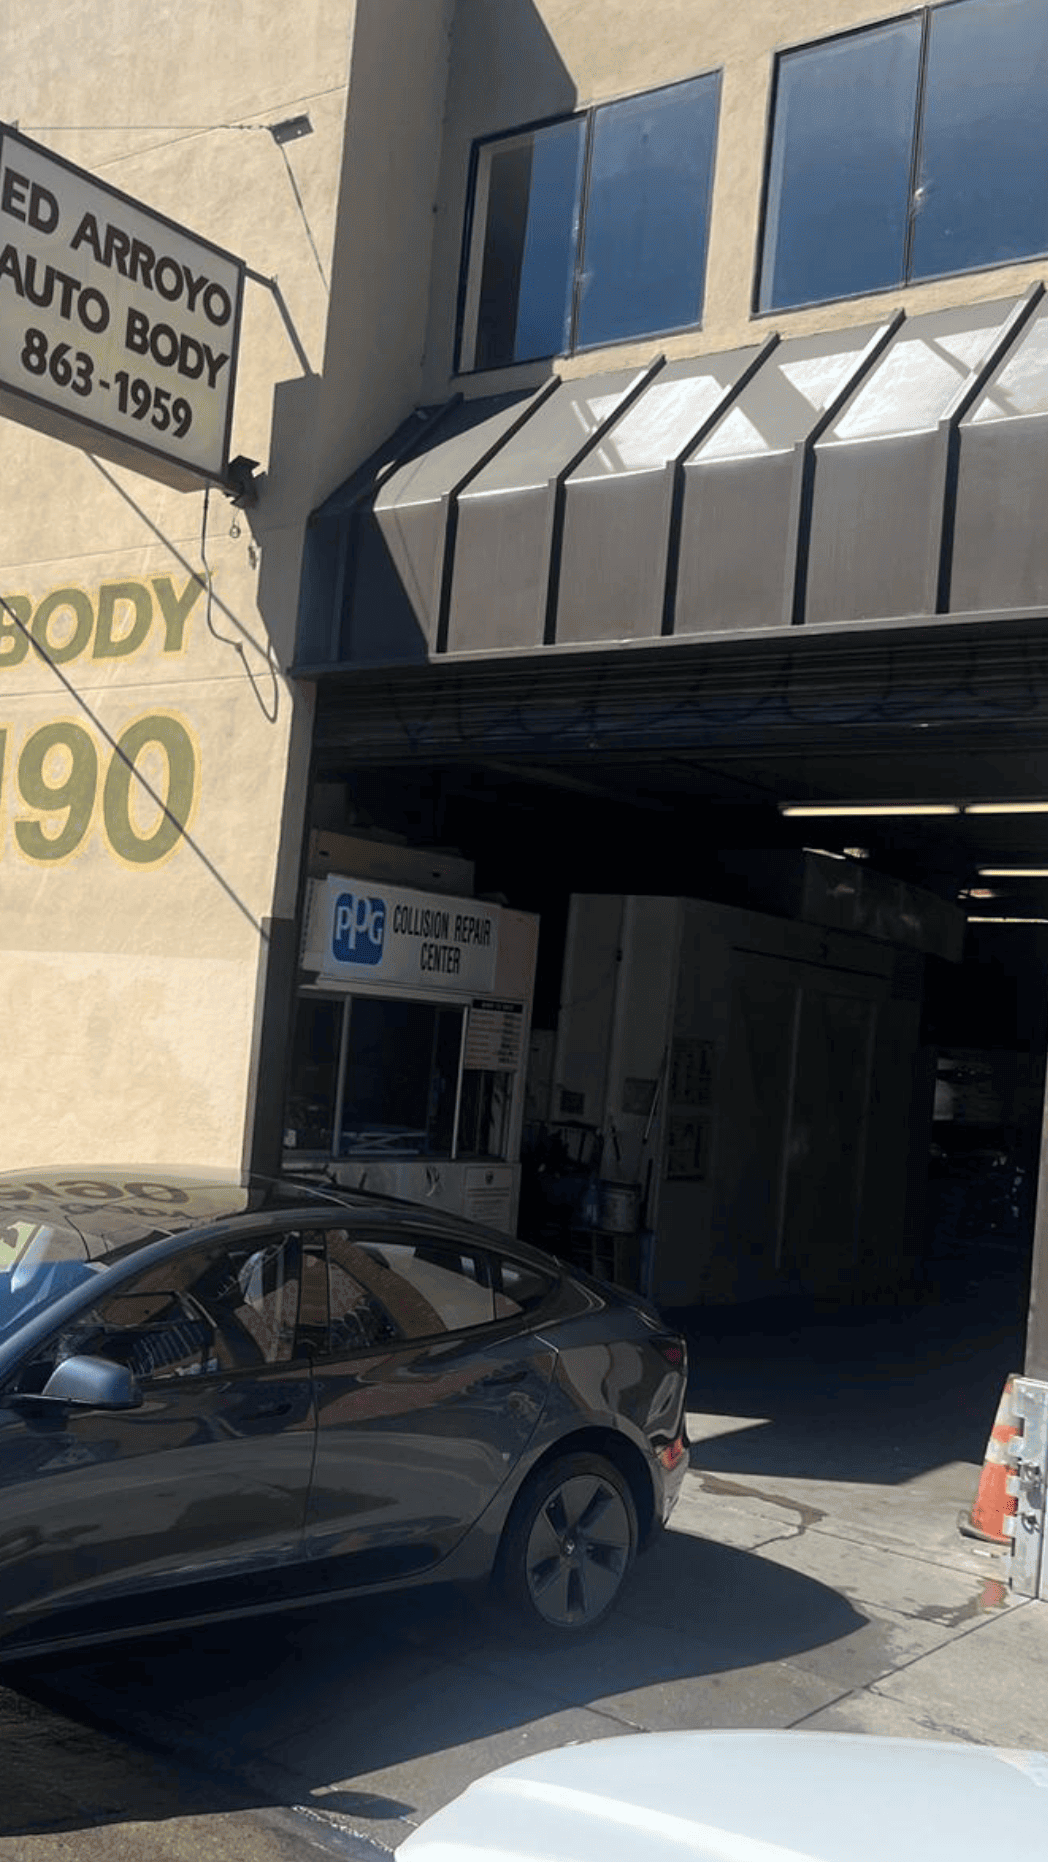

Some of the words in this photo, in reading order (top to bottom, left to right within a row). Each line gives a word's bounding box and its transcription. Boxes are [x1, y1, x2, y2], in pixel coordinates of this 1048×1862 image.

[1, 166, 59, 235] ED
[69, 211, 232, 327] ARROYO
[21, 328, 192, 439] 863-1959
[125, 306, 230, 389] BODY
[334, 896, 386, 950] PPG
[392, 904, 450, 940] COLLISION
[454, 913, 491, 946] REPAIR
[420, 942, 461, 974] CENTER
